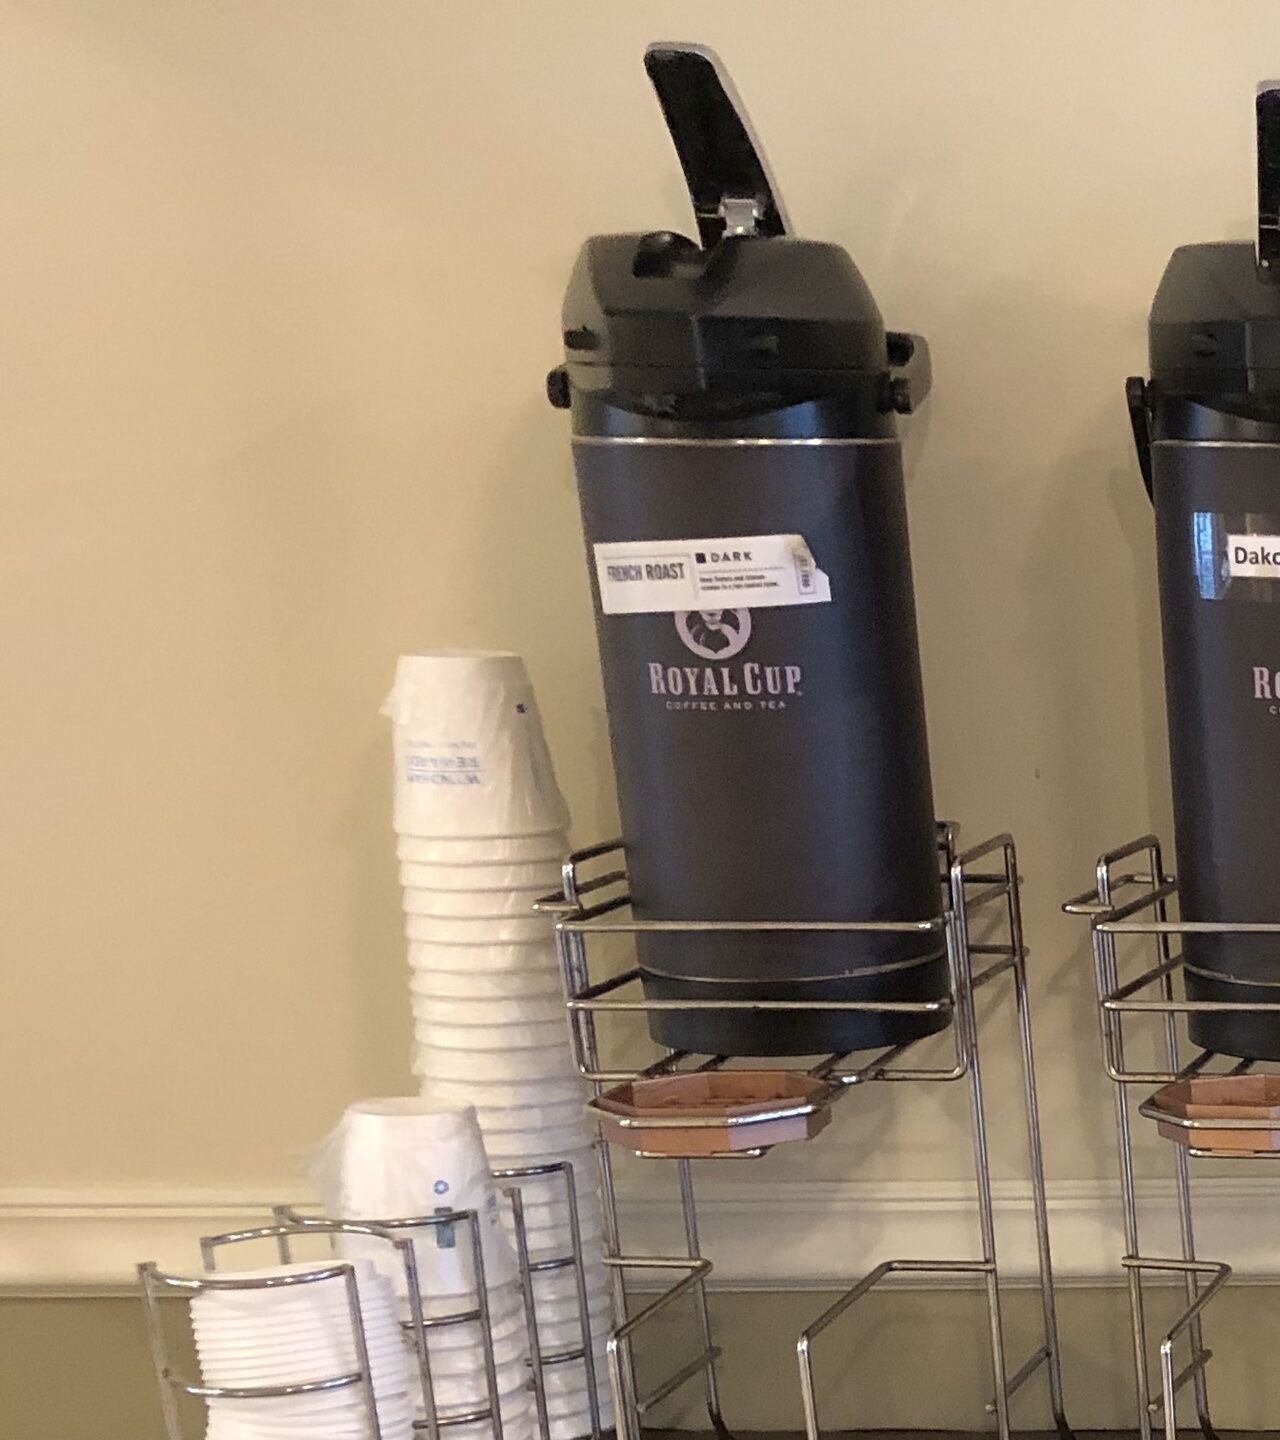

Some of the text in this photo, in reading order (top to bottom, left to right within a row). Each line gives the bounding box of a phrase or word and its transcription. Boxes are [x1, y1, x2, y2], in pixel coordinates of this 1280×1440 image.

[710, 551, 753, 563] DARK
[606, 562, 684, 581] FRENCH ROAST
[647, 662, 802, 696] ROYAL CUP
[665, 701, 787, 711] COFFEE AND TEA
